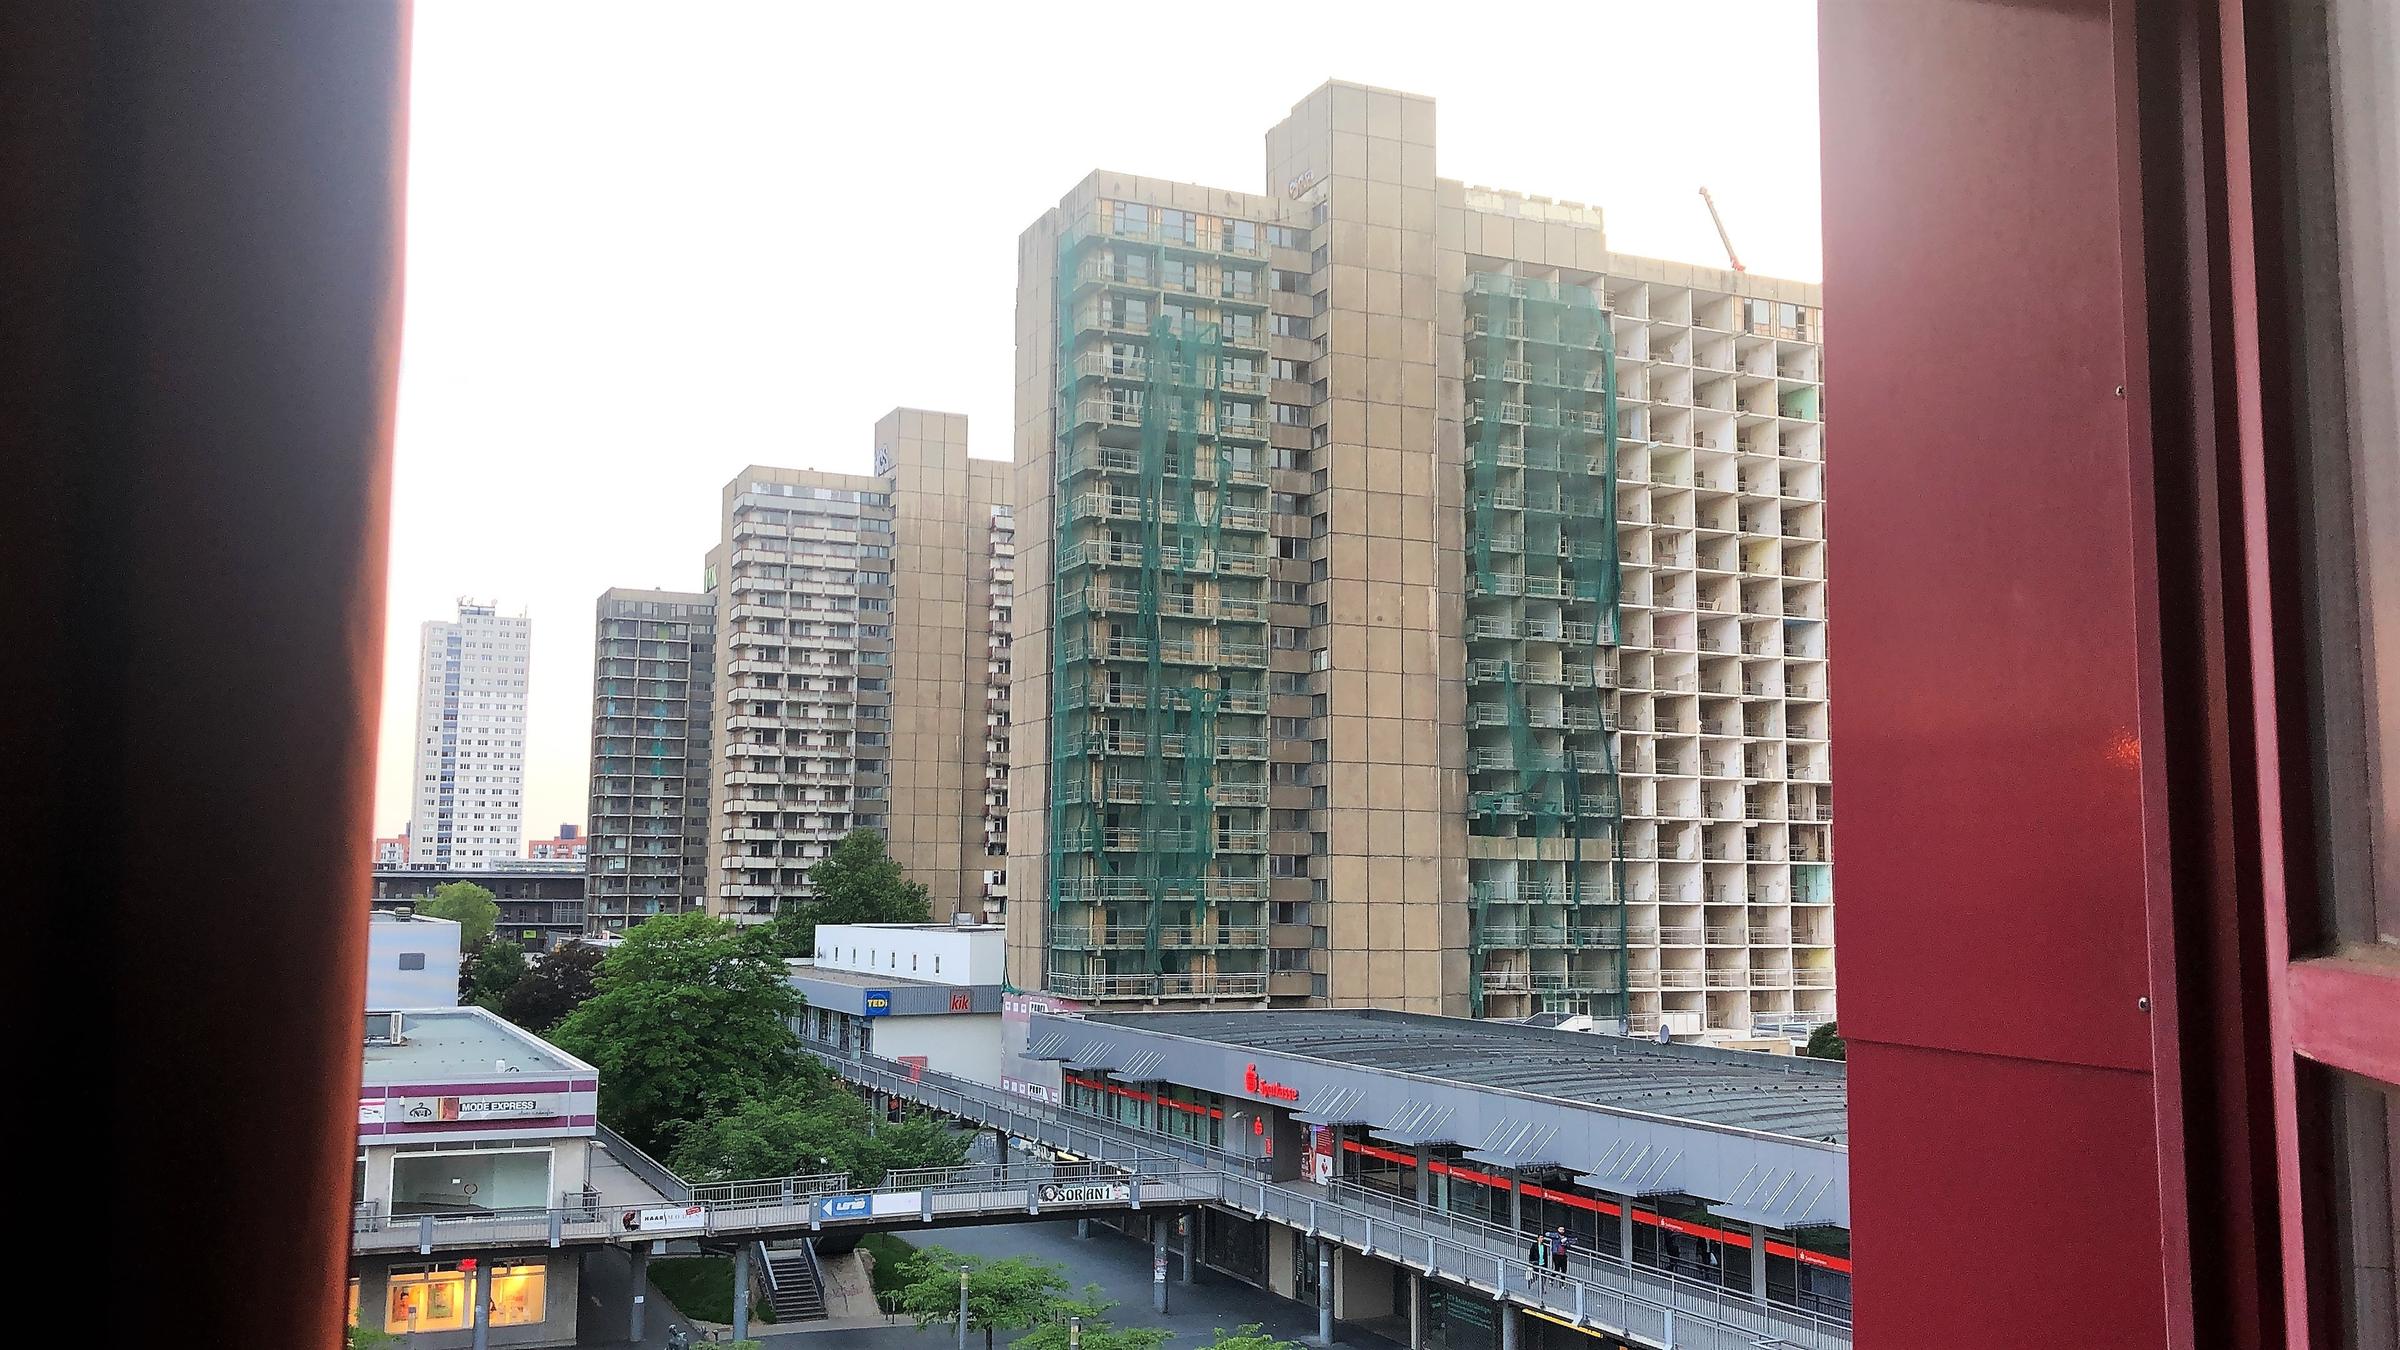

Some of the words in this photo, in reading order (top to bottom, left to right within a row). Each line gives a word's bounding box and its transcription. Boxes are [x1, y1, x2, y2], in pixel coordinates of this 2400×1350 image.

[867, 999, 888, 1008] TEDi
[1258, 1078, 1298, 1102] Sparkasse
[462, 1103, 489, 1111] MODE
[491, 1102, 534, 1111] EXPRESS
